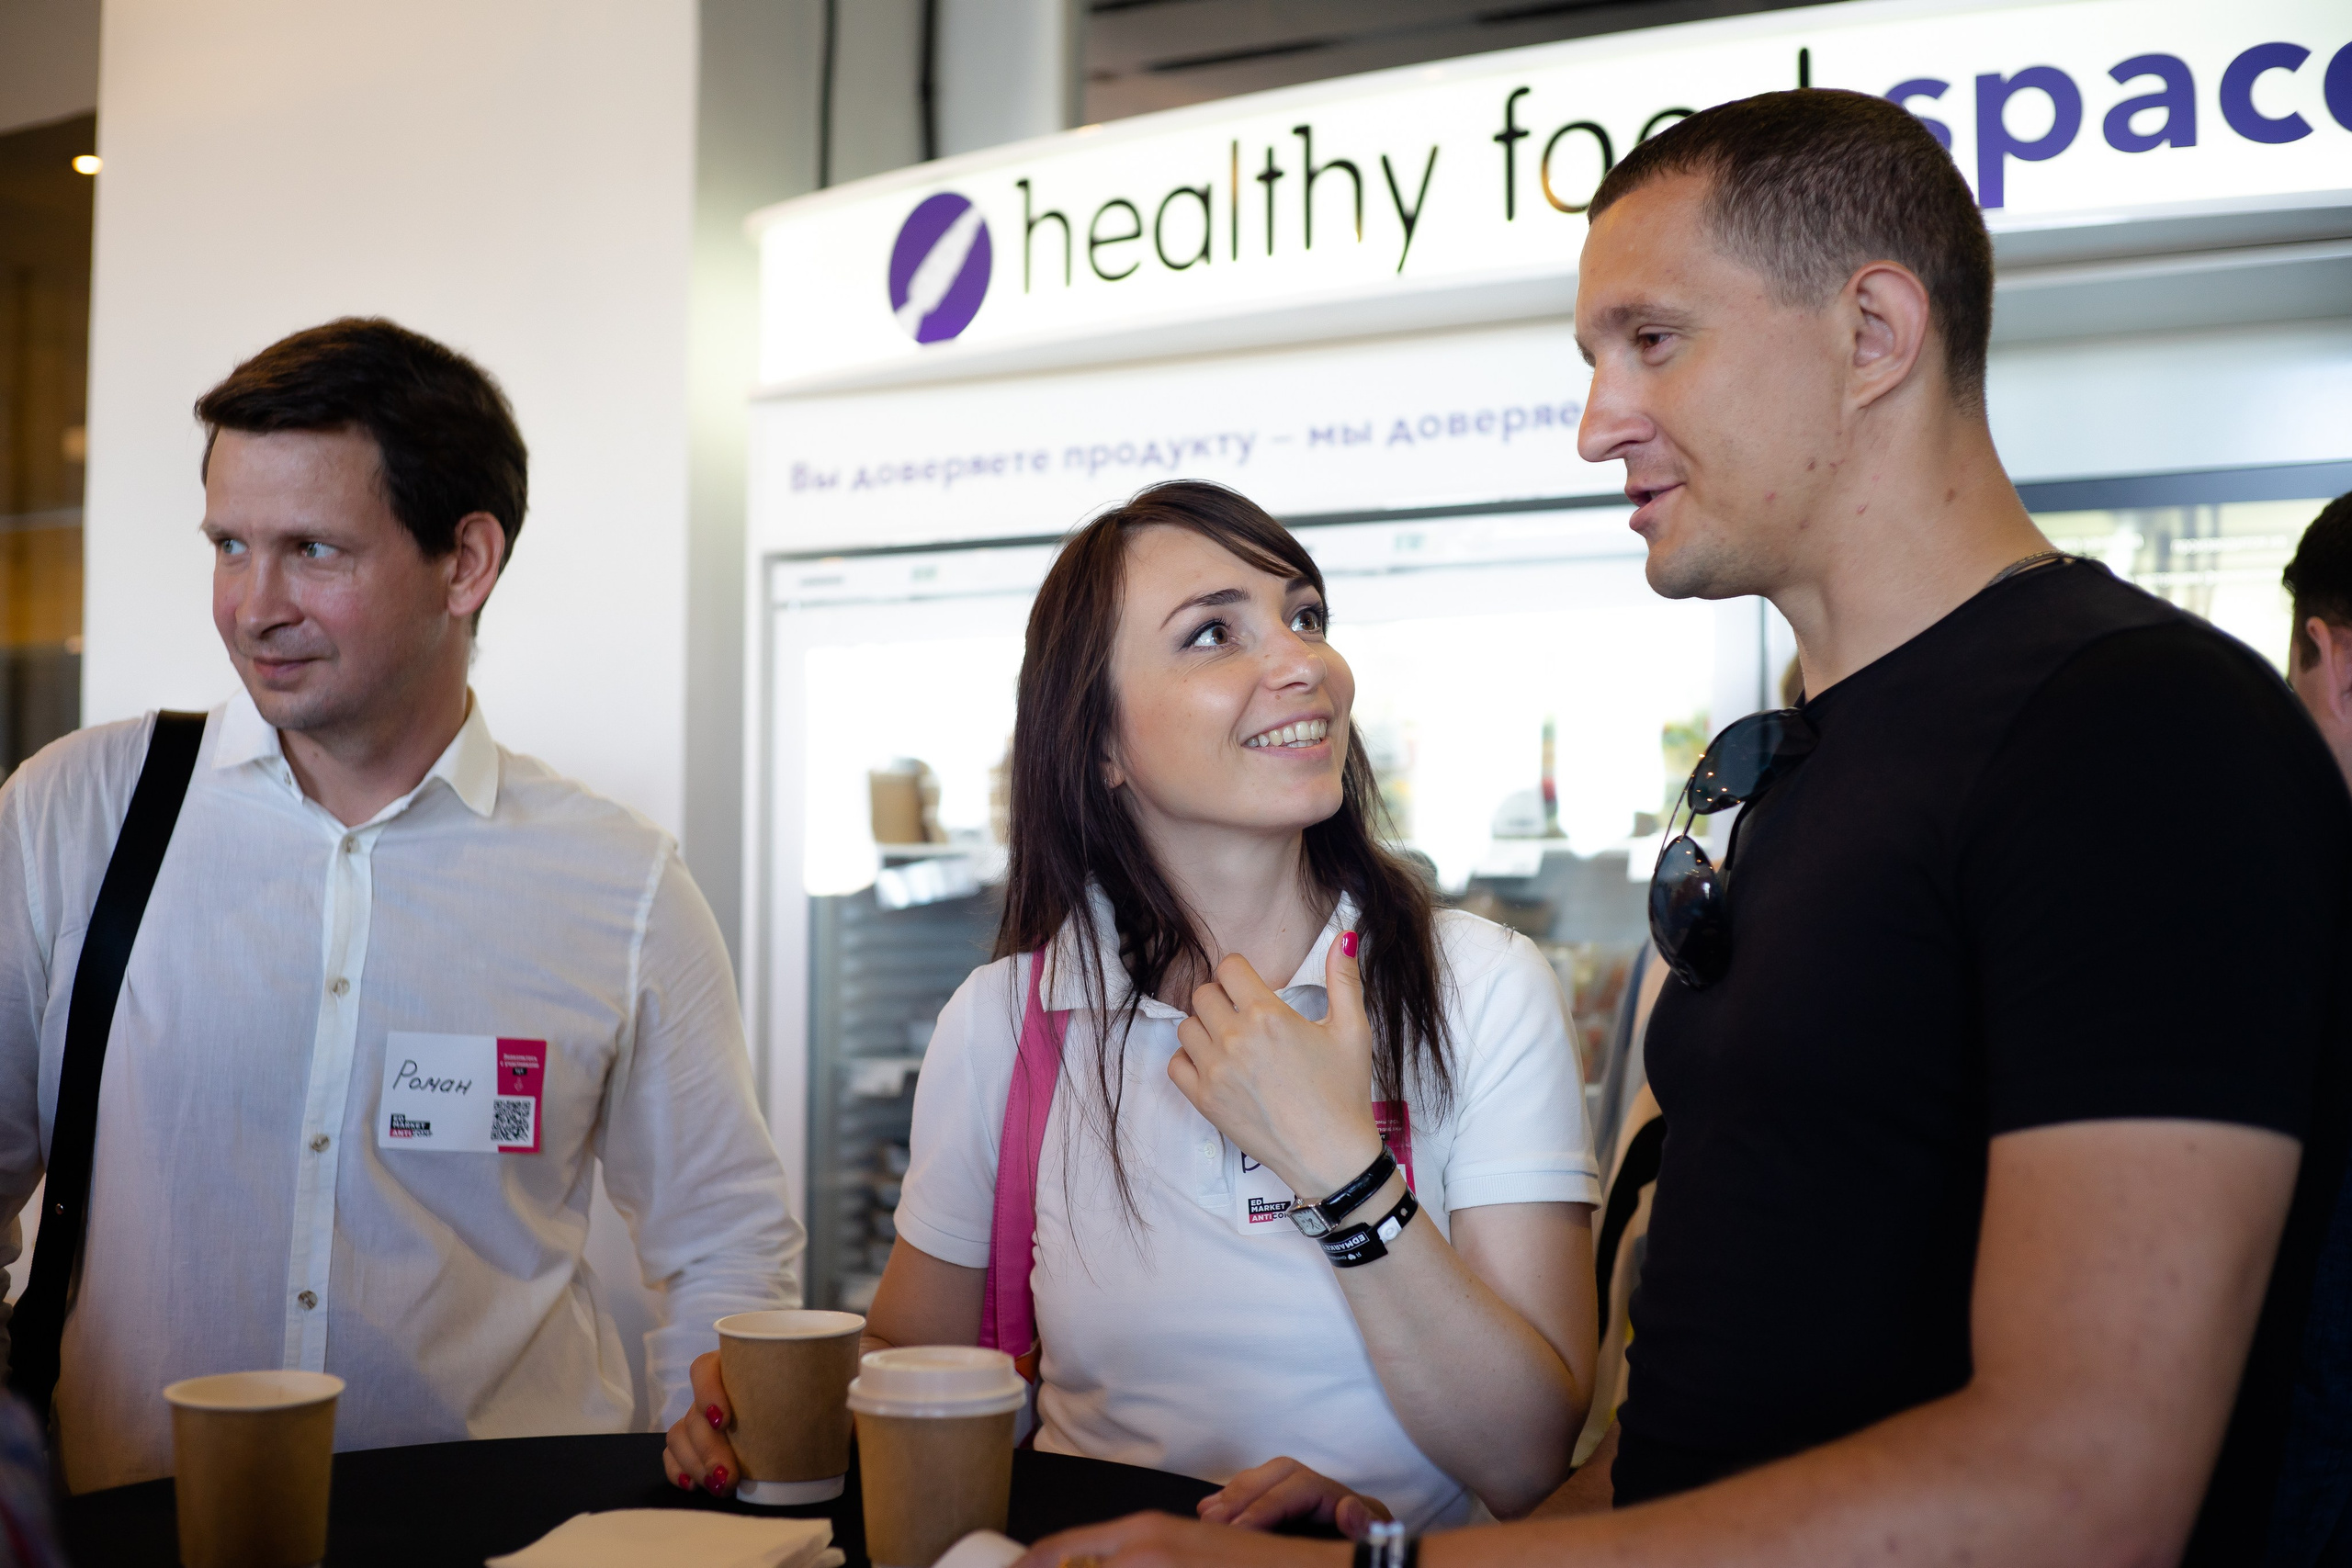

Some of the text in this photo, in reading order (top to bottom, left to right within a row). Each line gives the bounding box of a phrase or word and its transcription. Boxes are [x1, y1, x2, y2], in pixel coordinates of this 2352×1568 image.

[1016, 40, 2352, 293] healthy fo spac
[791, 462, 840, 492] Вы
[854, 448, 1047, 491] доверяете
[1064, 430, 1256, 477] продукту
[1307, 420, 1373, 448] мы
[392, 1059, 472, 1096] Роман
[1251, 1202, 1286, 1213] MARKET
